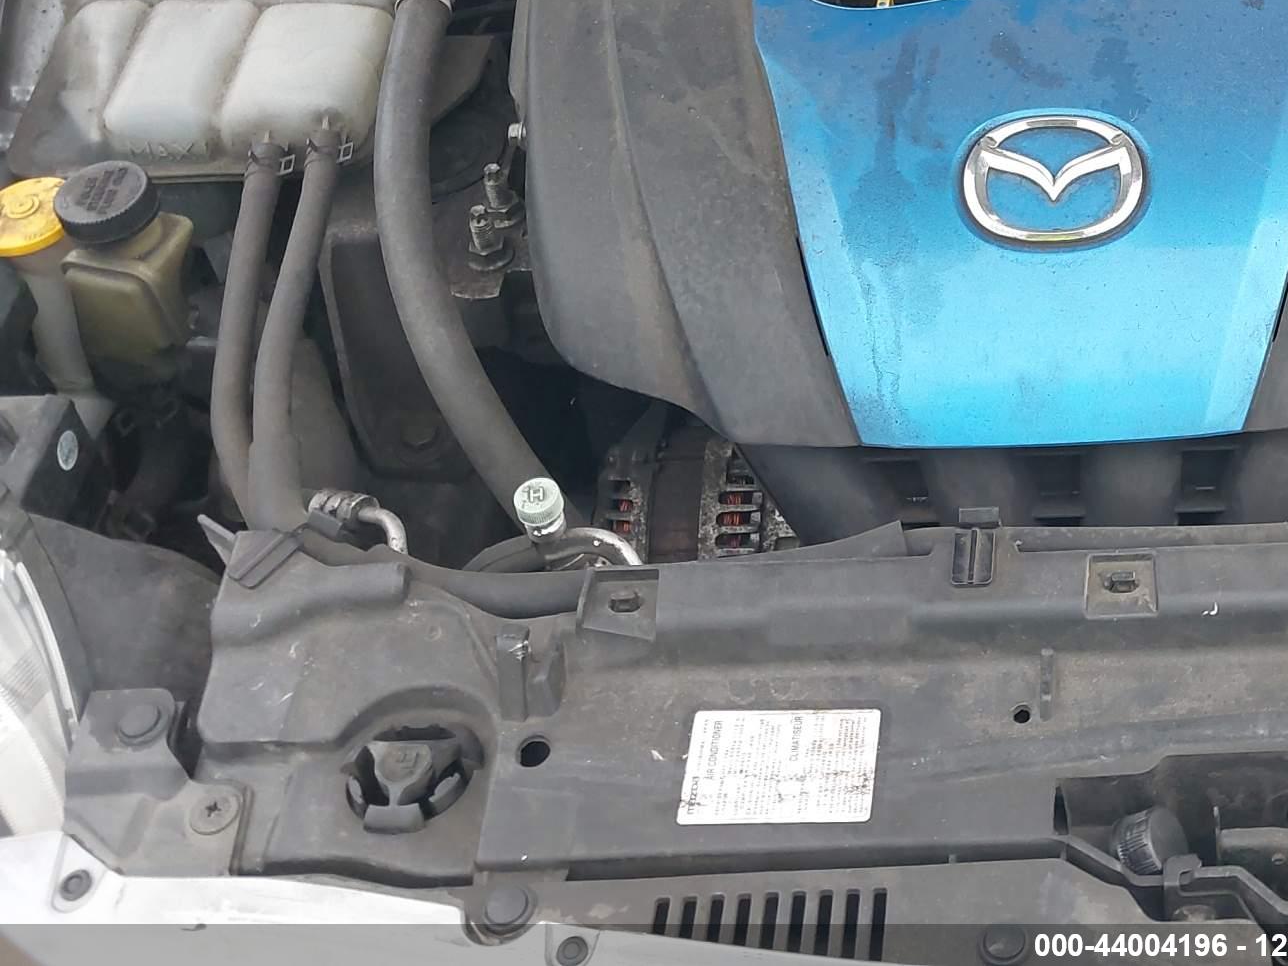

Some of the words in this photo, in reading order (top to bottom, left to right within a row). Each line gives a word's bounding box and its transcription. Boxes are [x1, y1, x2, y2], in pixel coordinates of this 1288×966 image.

[528, 486, 545, 503] H
[708, 721, 723, 767] CONDITIONER
[789, 716, 803, 762] CLIMATISEUR
